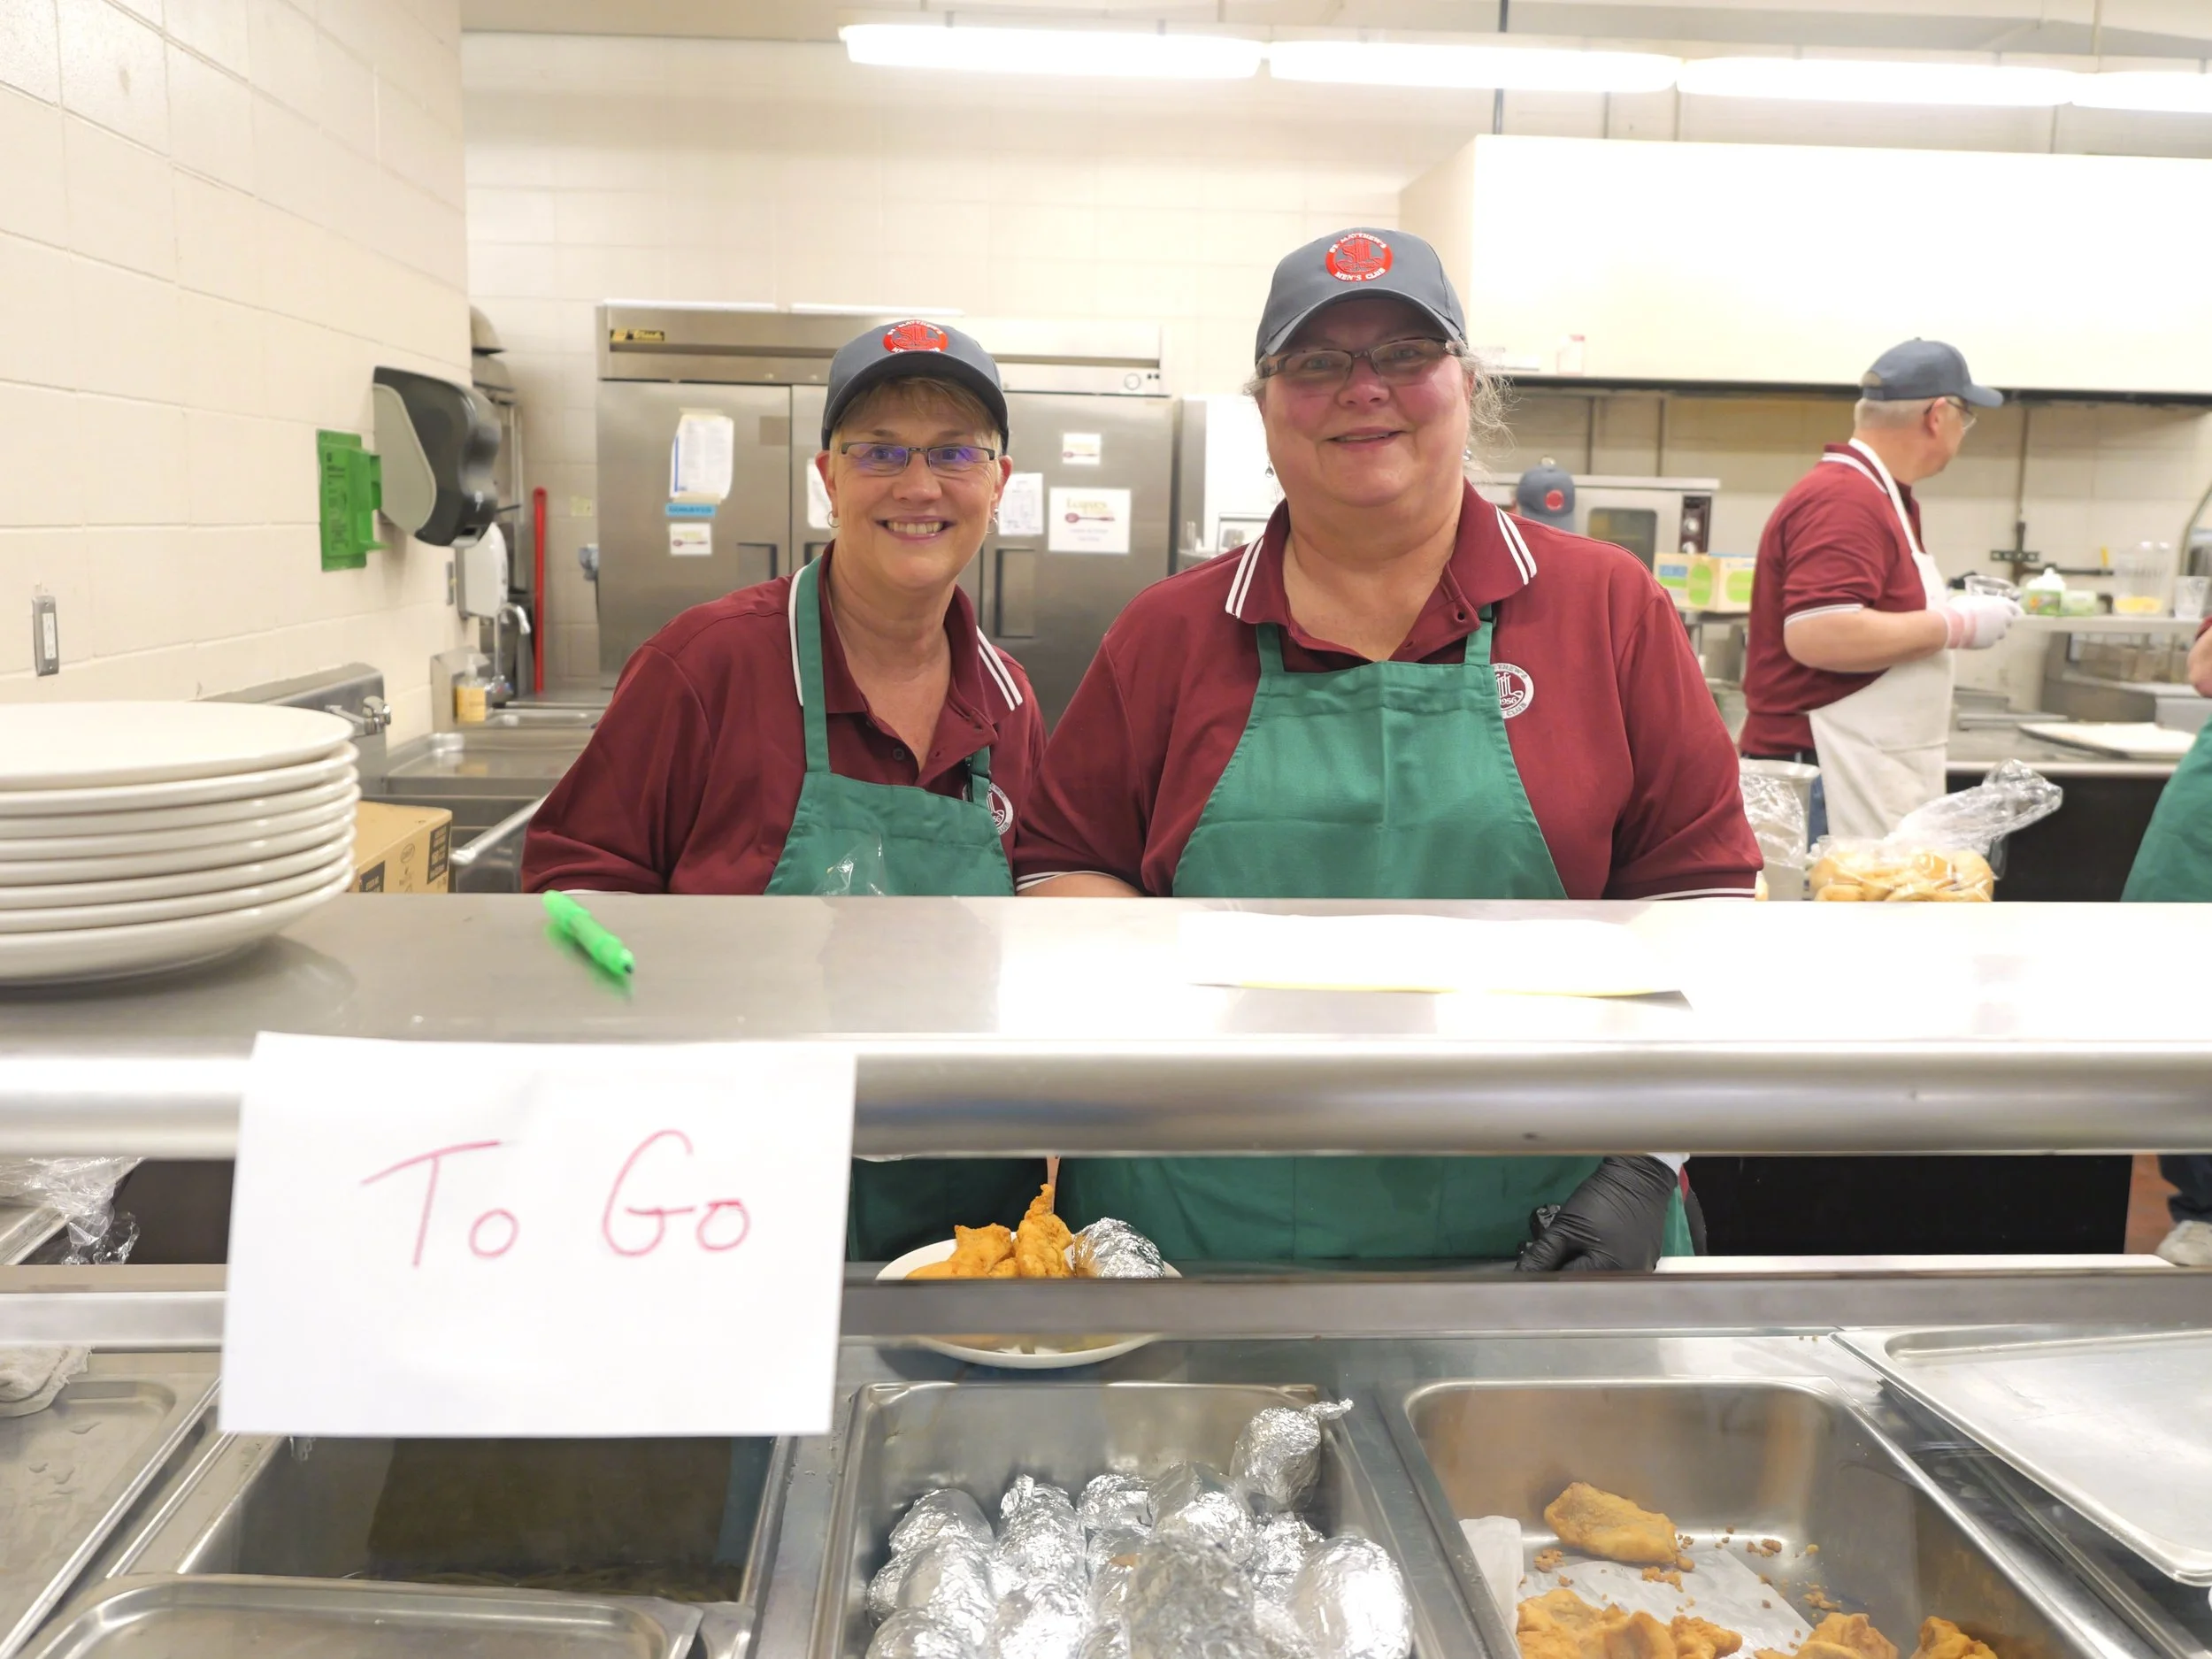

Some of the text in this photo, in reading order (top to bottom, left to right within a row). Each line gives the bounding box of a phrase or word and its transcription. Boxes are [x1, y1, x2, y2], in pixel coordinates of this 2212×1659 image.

[1334, 267, 1386, 281] MEN'S CLUB
[1506, 702, 1527, 717] CLUB
[360, 1129, 751, 1268] To Go
